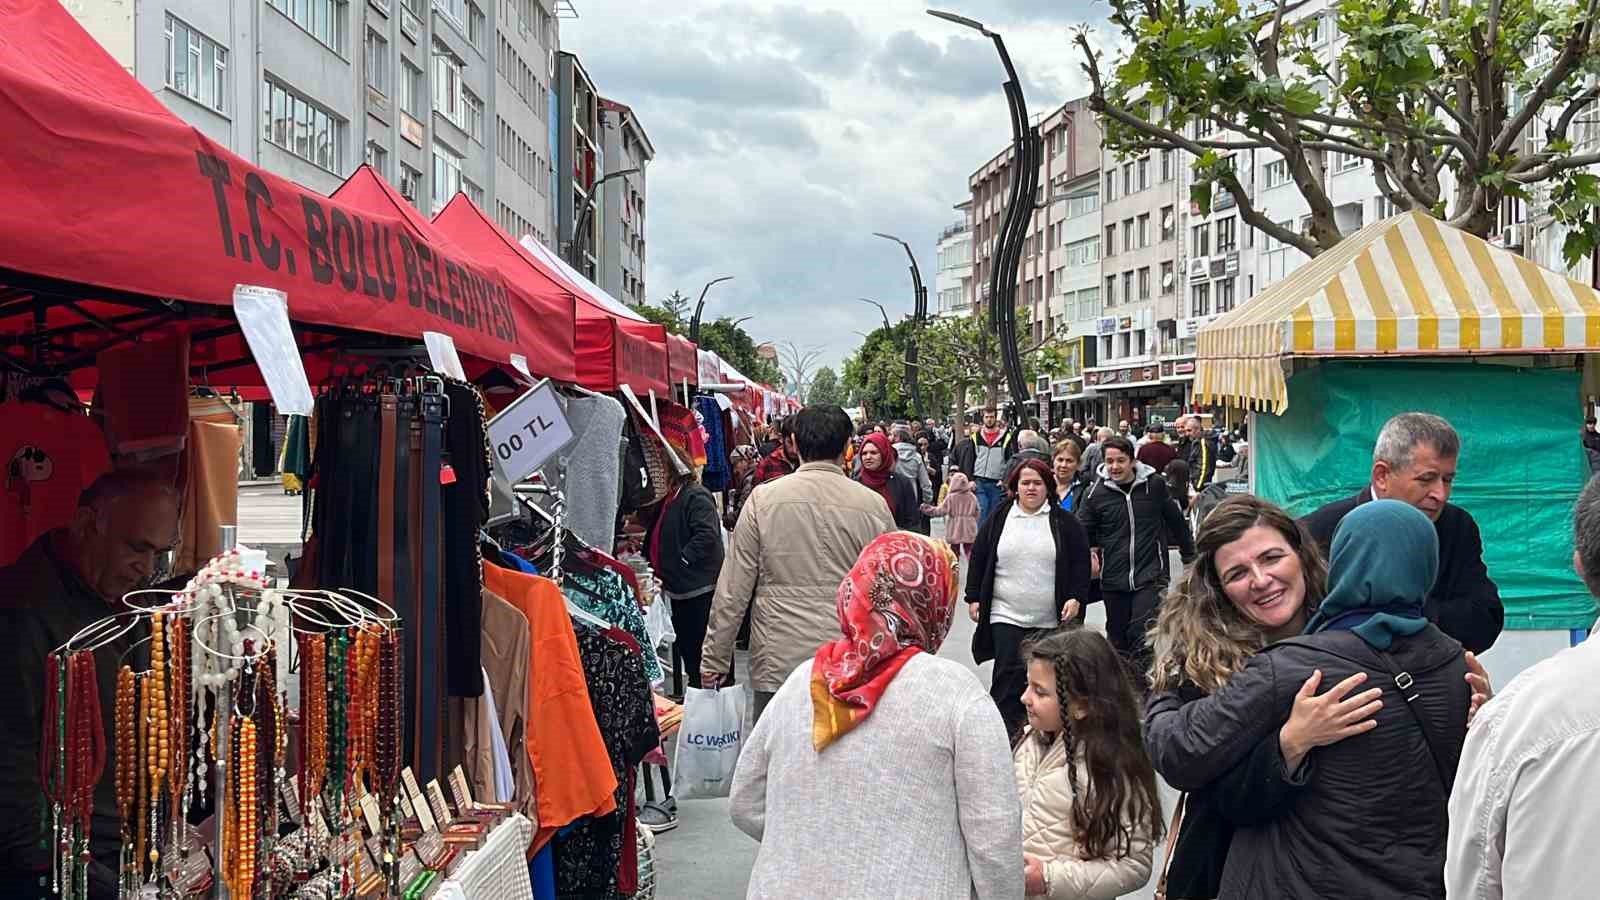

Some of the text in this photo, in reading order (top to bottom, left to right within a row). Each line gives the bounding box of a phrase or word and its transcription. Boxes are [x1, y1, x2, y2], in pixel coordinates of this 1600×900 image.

[195, 150, 296, 275] T.C.
[300, 193, 397, 301] BOLU
[523, 415, 554, 438] TL
[687, 732, 704, 745] LC
